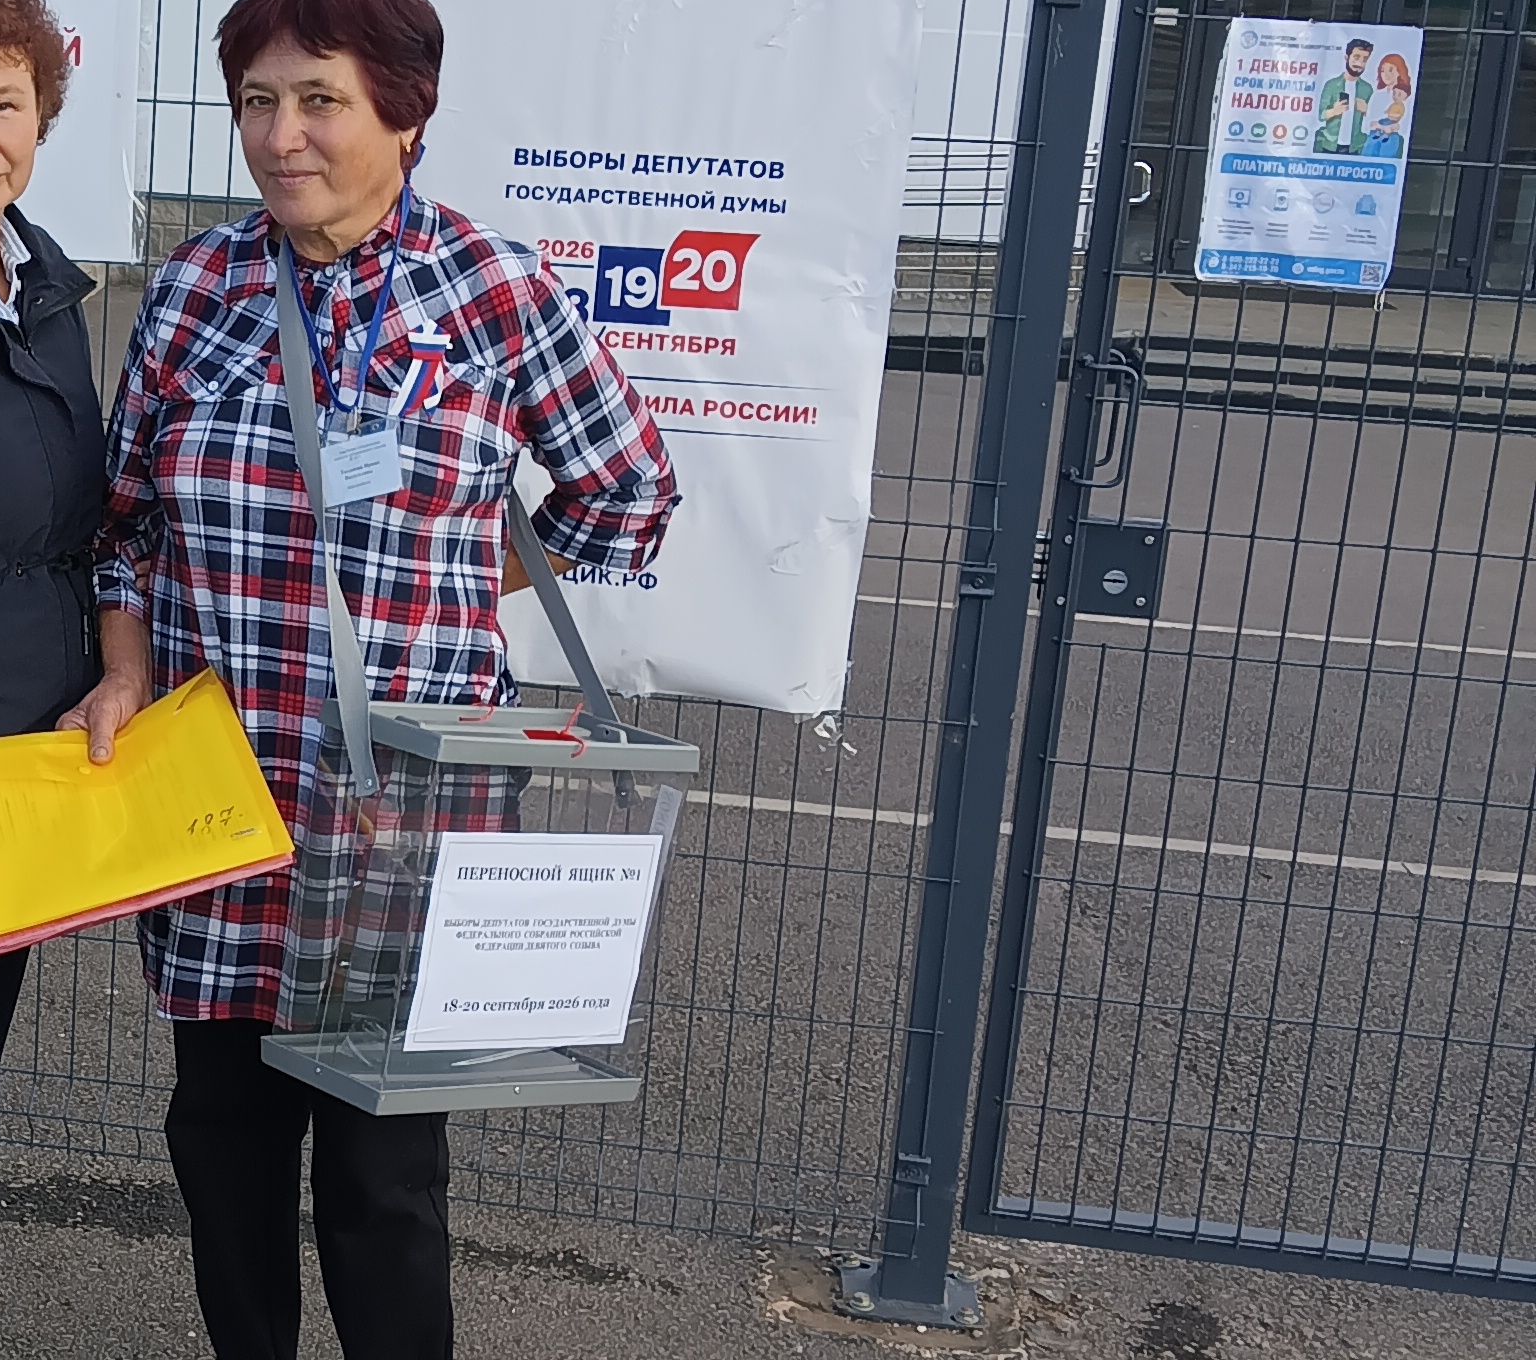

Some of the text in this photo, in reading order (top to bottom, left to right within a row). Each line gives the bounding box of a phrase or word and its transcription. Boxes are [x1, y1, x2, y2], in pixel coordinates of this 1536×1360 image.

[1237, 58, 1318, 75] 1 ДЕКАБРЯ
[1233, 76, 1264, 89] СРОК
[1231, 92, 1314, 112] НАЛОГОВ
[514, 147, 785, 179] ВЫБОРЫ ДЕПУТАТОВ
[1232, 158, 1384, 180] ПЛАТИТЬ НАЛОГИ ПРОСТО
[505, 184, 787, 214] ГОСУДАРСТВЕННОЙ ДУМЫ
[536, 238, 594, 259] 2026
[604, 265, 657, 309] 19
[669, 247, 737, 292] 20
[604, 330, 736, 355] СЕНТЯБРЯ
[644, 395, 818, 424] ИЛА РОССИИ!
[457, 864, 641, 883] ПЕРЕНОСНОЙ ЯЩИК №1
[444, 916, 637, 928] ВЫБОРЫ ДЕПУТАТОВ ГОСУДАРСТВЕННОЙ ДУМЫ
[456, 928, 622, 939] ФЕДЕРАЛЬНОГО СОБРАНИЯ РОССИЙСКОЙ
[474, 942, 601, 951] ФЕДЕРАЦИИ ДЕВЯТОГО СОЗЫВА
[443, 996, 610, 1013] 18-20 сентября 2026 года
